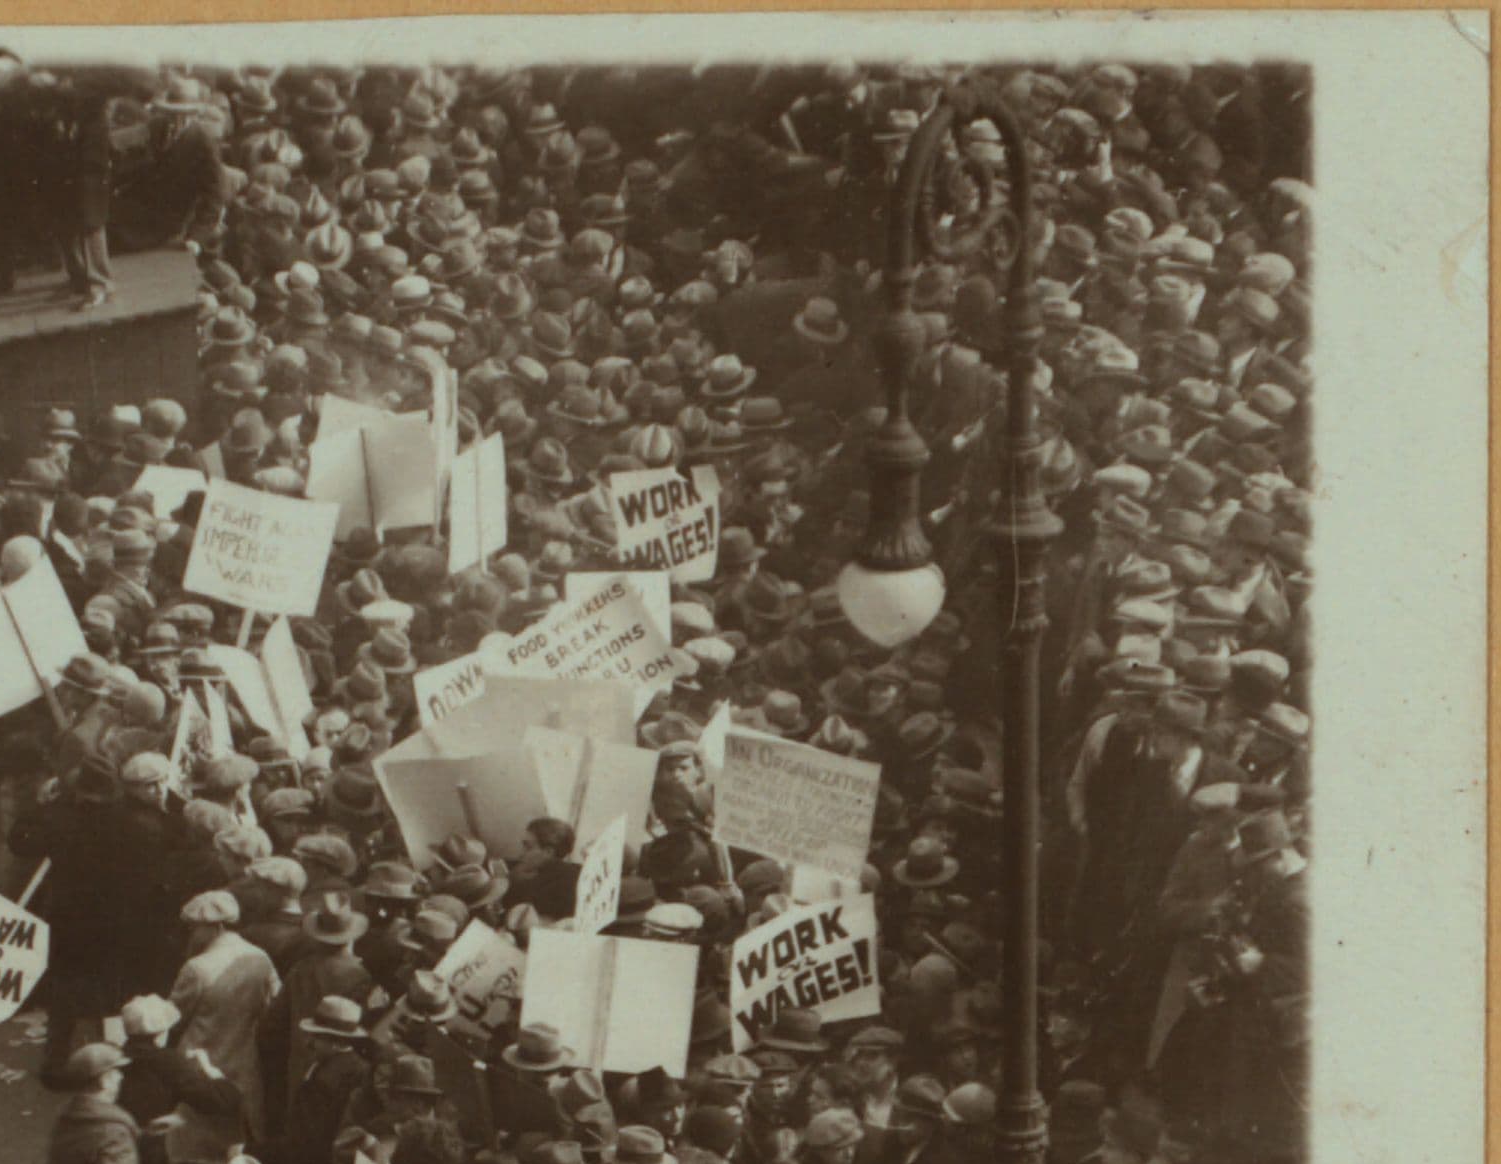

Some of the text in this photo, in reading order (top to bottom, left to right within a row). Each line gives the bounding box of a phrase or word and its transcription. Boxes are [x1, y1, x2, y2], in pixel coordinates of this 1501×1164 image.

[618, 479, 702, 528] WORK
[622, 505, 715, 569] WAGES!
[507, 631, 549, 666] FOOD
[544, 618, 611, 669] BREAK
[736, 905, 850, 990] WORK
[735, 938, 874, 1042] WAGES!
